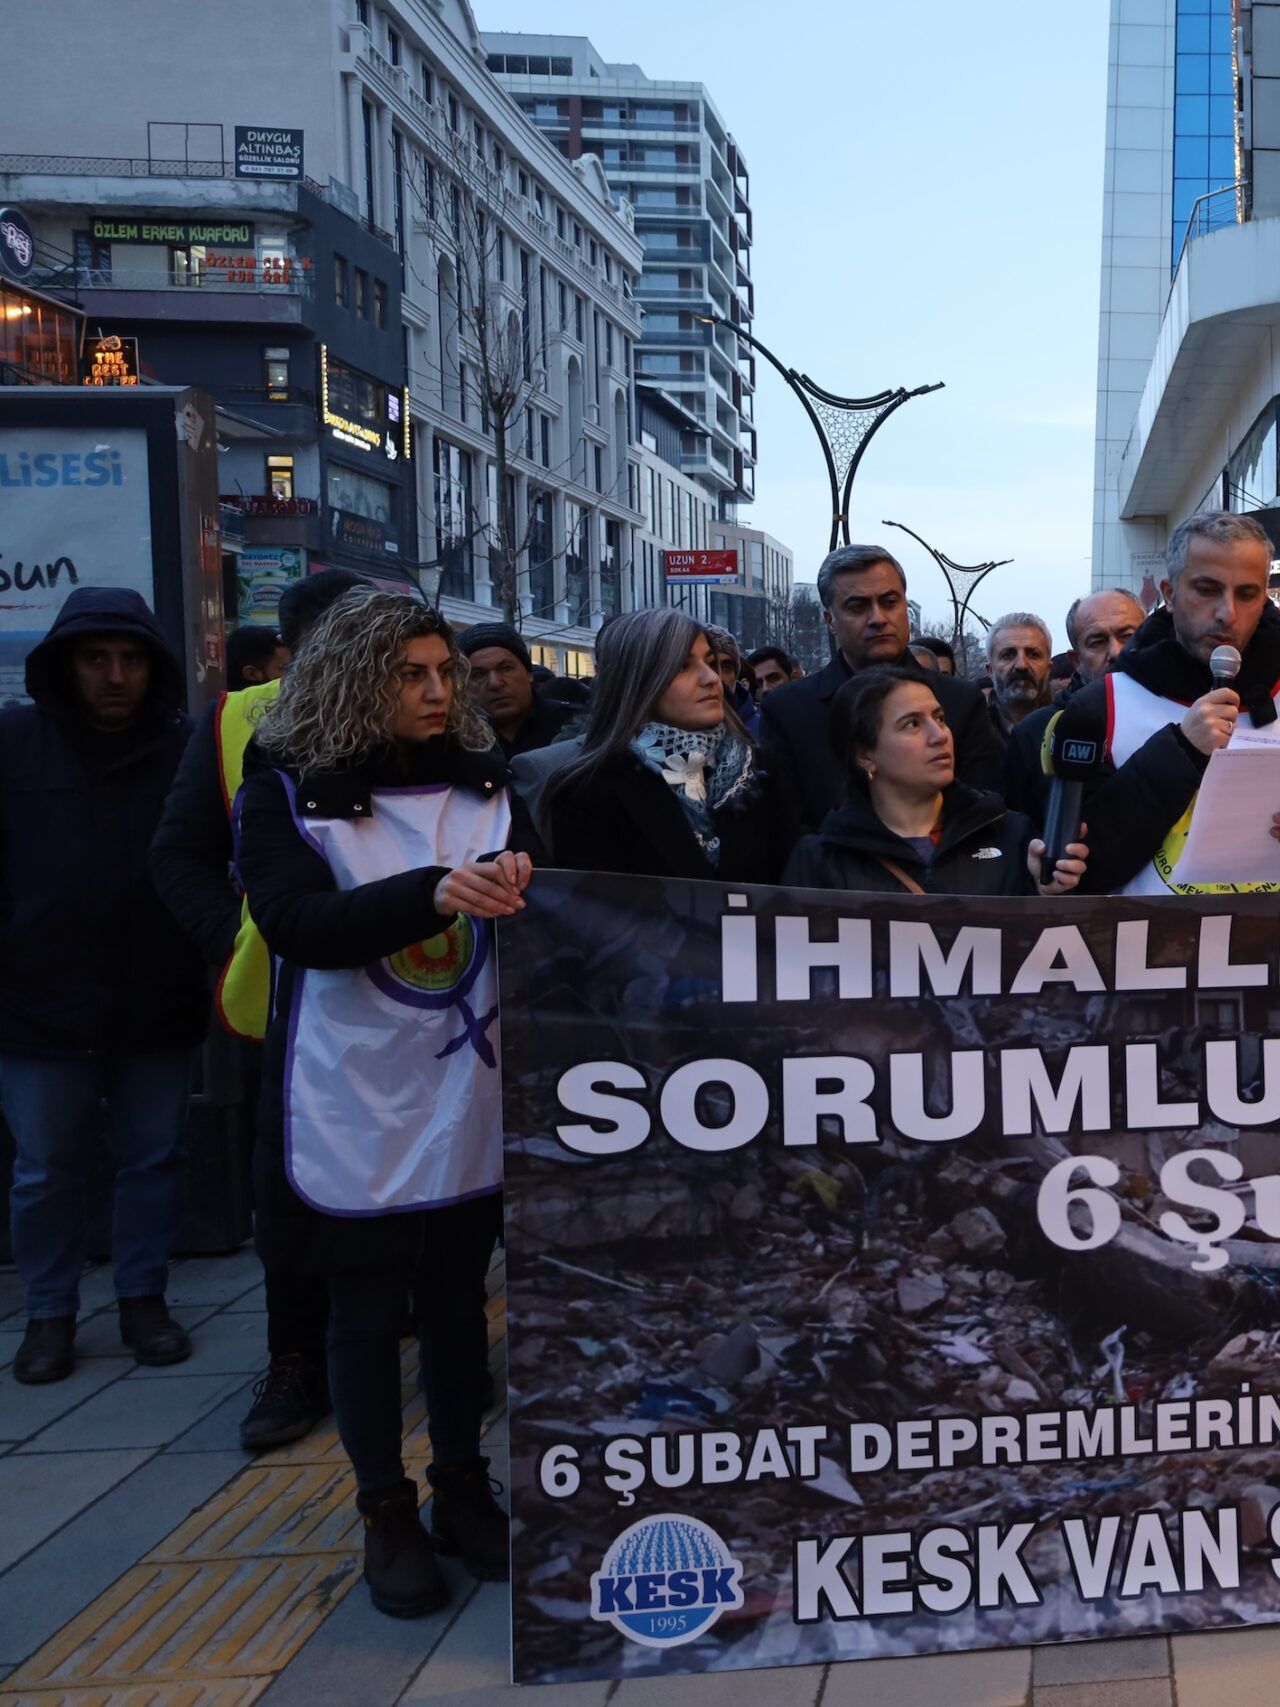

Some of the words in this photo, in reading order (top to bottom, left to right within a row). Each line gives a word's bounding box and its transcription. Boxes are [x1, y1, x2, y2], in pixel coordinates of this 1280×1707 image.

[247, 131, 292, 143] DUYGU
[238, 142, 301, 158] ALTINBAŞ
[94, 221, 138, 241] ÖZLEM
[142, 224, 184, 241] ERKEK
[189, 225, 249, 243] KUAFÖRÜ
[669, 555, 695, 565] UZUN
[701, 555, 711, 565] 2.
[1037, 1154, 1122, 1252] 6
[540, 1445, 581, 1497] 6
[604, 1426, 827, 1506] ŞUBAT
[797, 1522, 1041, 1620] KESK
[1065, 1507, 1240, 1599] VAN
[597, 1567, 737, 1614] KESK
[650, 1615, 686, 1633] 1995
